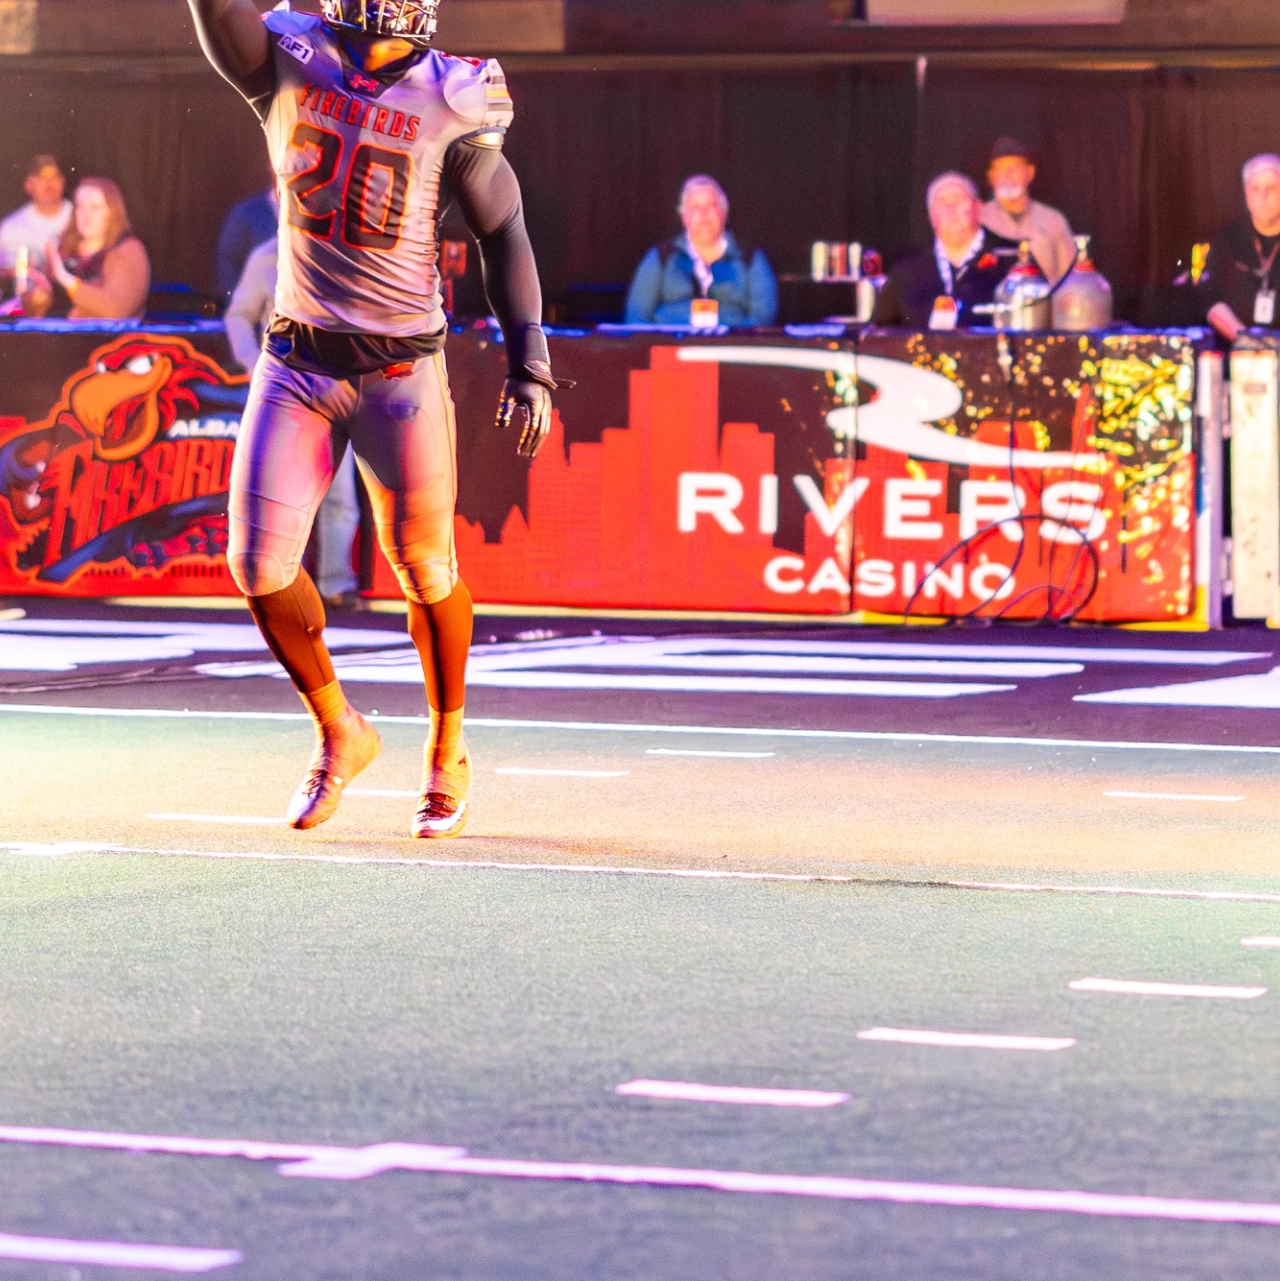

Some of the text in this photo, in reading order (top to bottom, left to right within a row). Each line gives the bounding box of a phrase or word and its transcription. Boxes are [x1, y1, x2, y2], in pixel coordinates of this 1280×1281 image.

[300, 82, 421, 142] FIREBIRDS
[286, 121, 416, 253] 20
[677, 470, 1108, 544] RIVERS
[763, 556, 1018, 601] CASINO
